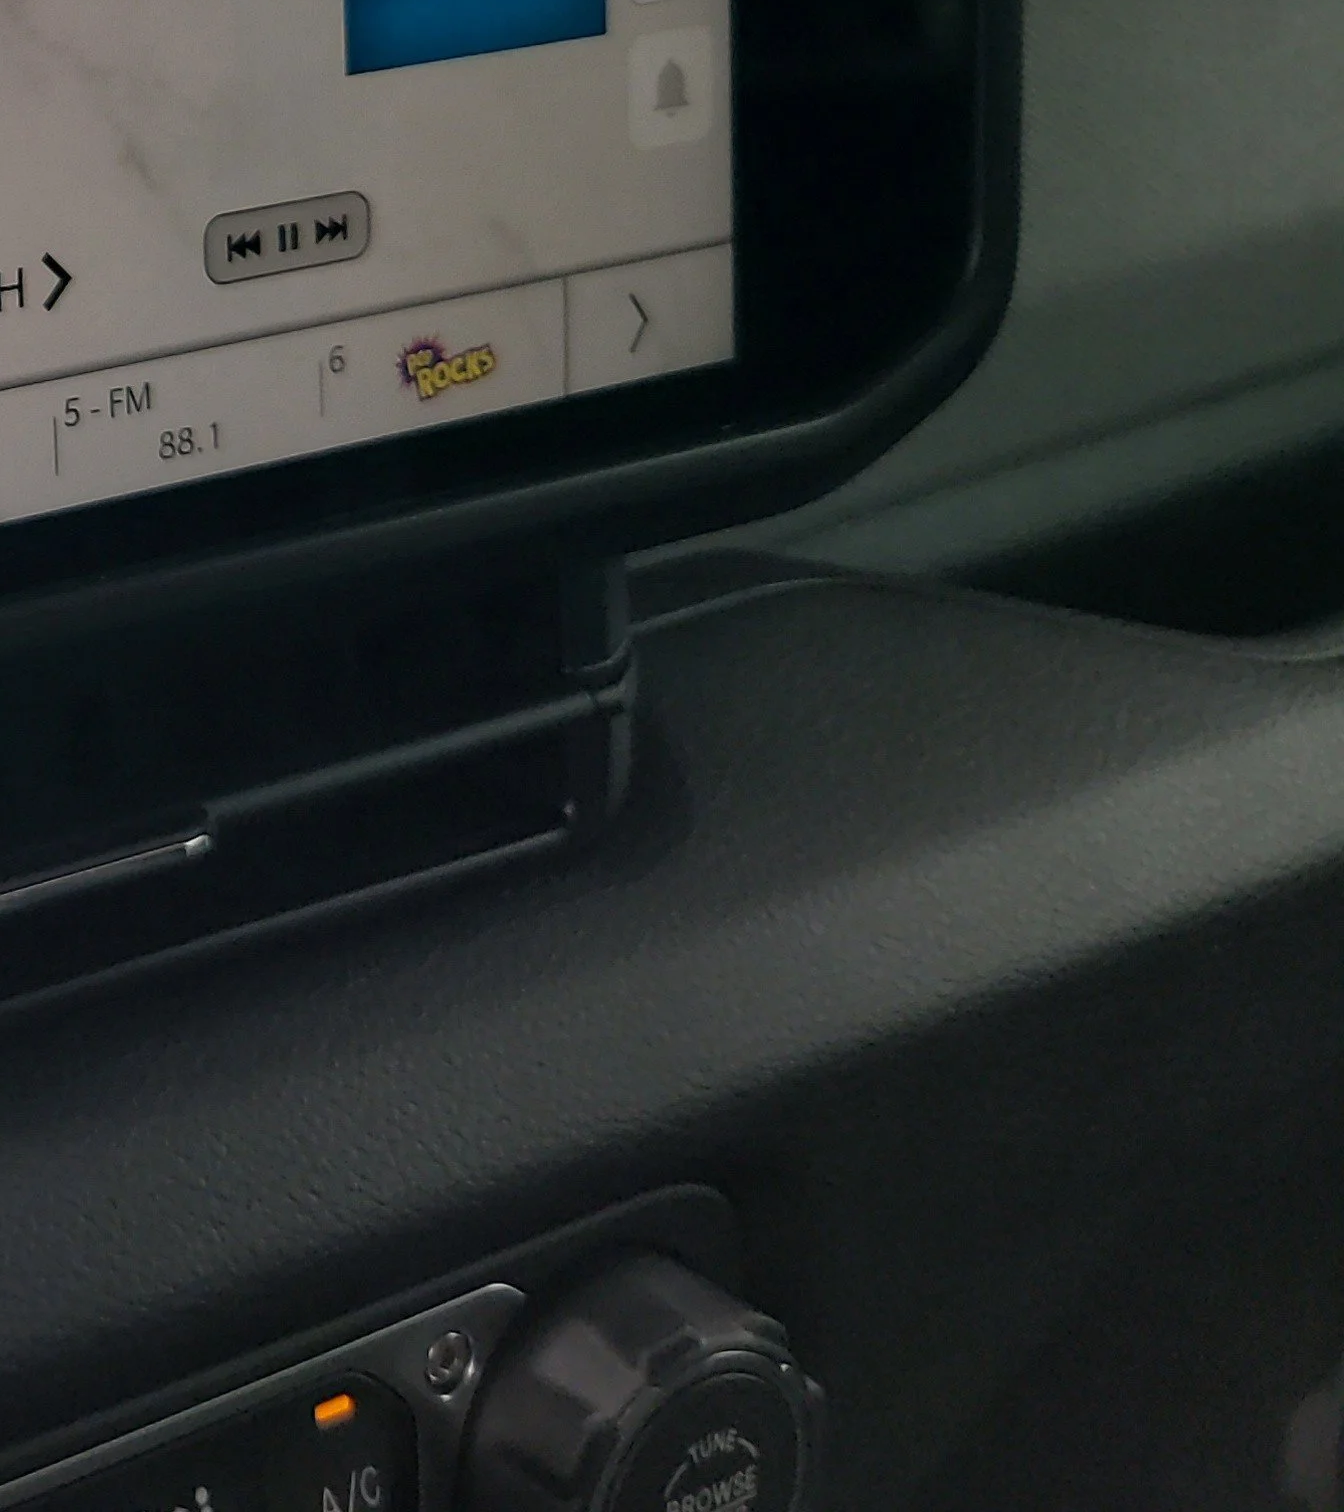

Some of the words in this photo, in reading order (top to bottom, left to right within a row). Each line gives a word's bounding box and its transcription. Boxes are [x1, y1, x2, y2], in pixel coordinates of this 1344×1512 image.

[328, 345, 345, 375] 6
[416, 348, 494, 399] ROCKS
[64, 397, 80, 427] 5
[109, 381, 152, 418] FM
[158, 421, 220, 459] 88.1
[688, 1428, 738, 1464] TUNE
